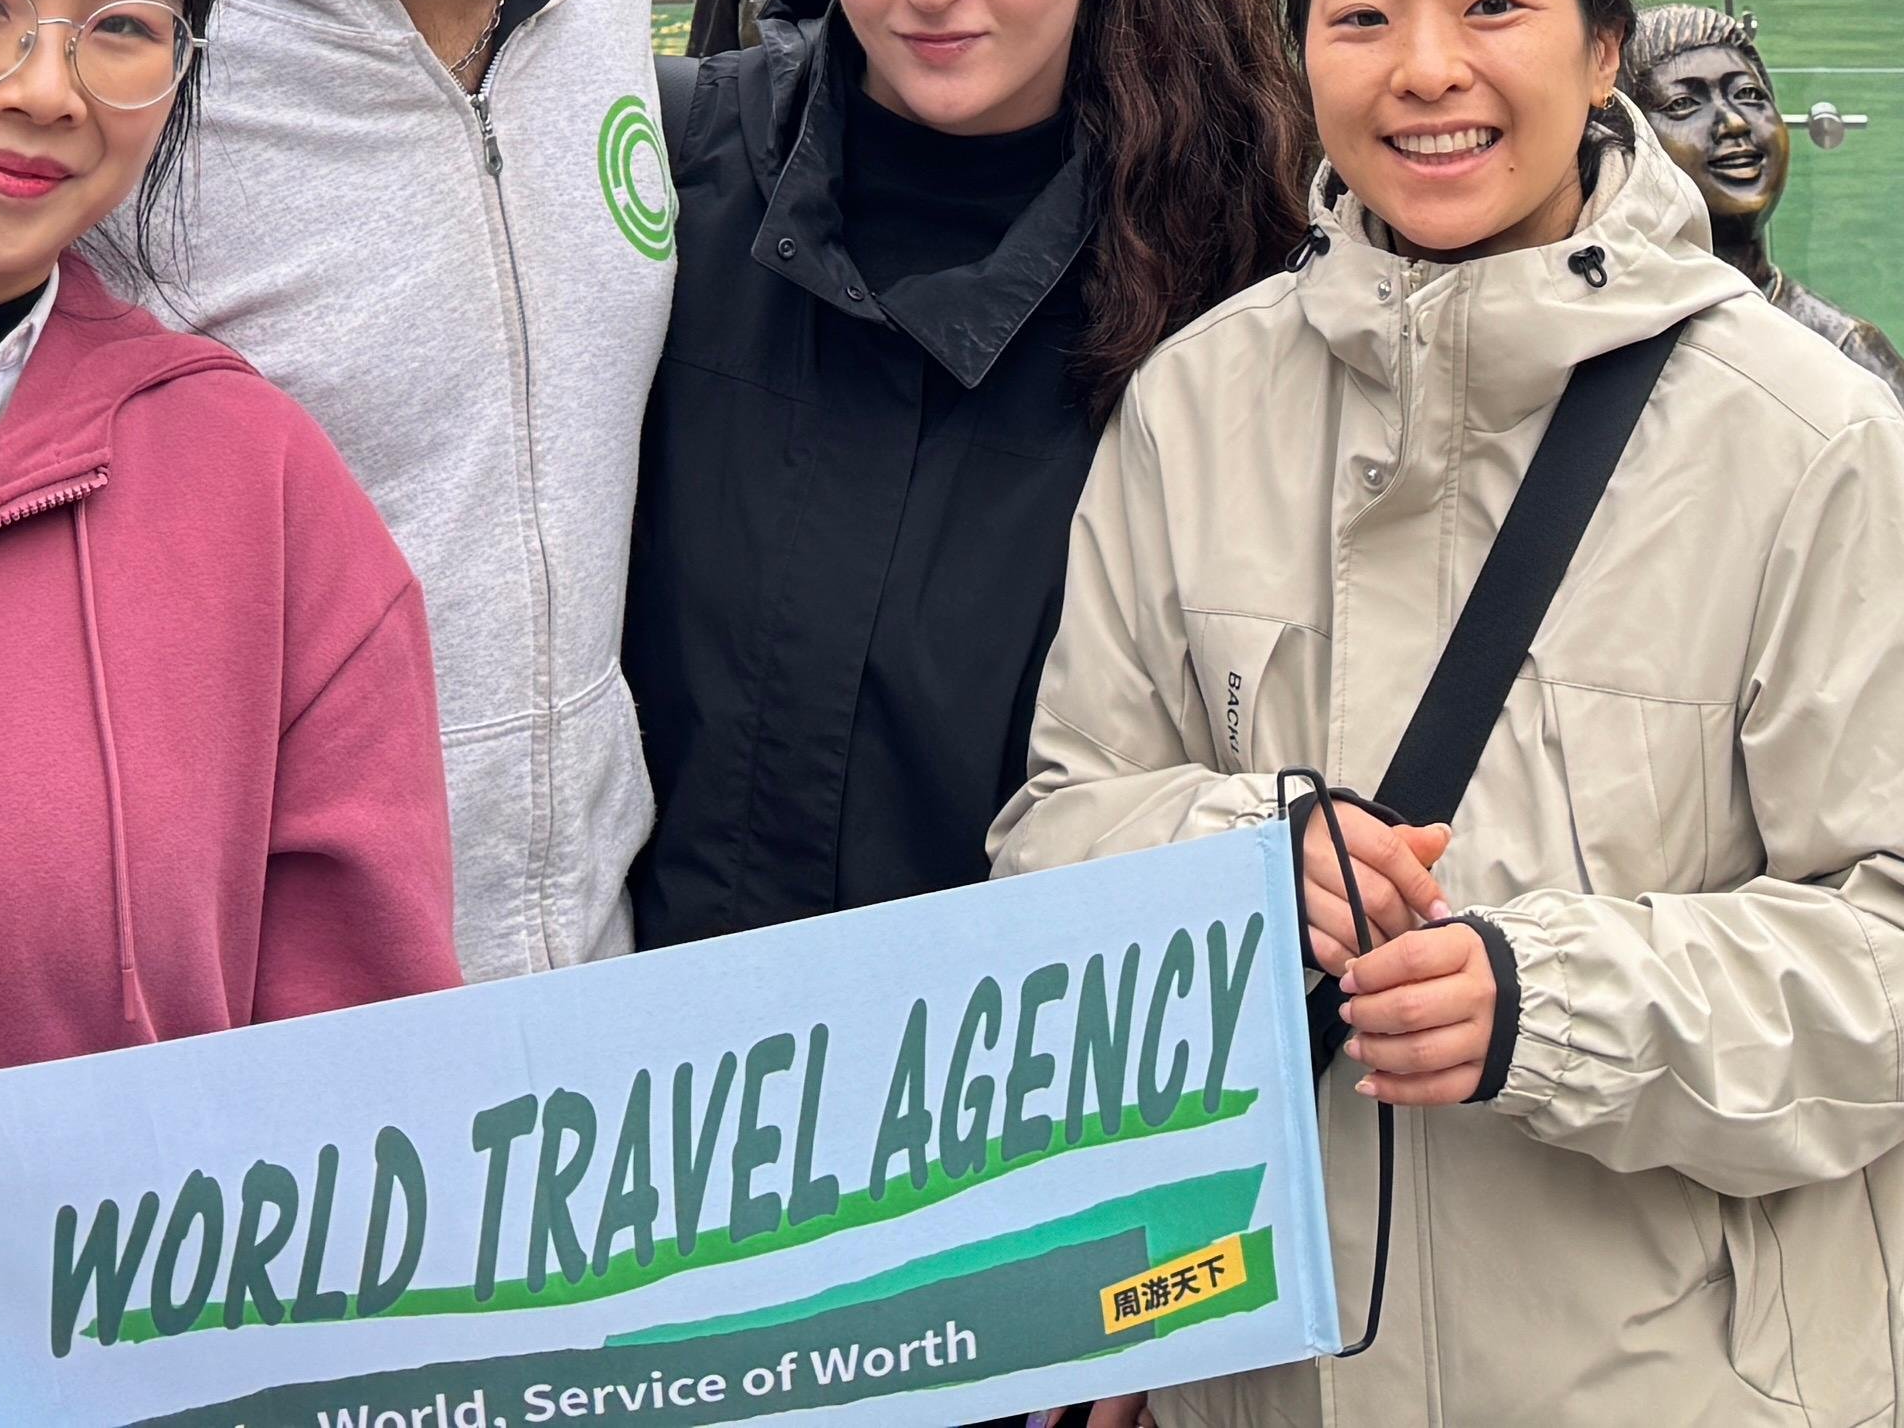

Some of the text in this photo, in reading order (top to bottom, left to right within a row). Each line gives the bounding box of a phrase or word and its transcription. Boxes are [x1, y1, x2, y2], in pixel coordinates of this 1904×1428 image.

[51, 912, 1264, 1358] WORLD TRAVEL AGENCY
[1113, 1254, 1225, 1322] 周游天下
[524, 1370, 726, 1423] Service
[743, 1351, 799, 1396] of
[810, 1320, 977, 1385] Worth
